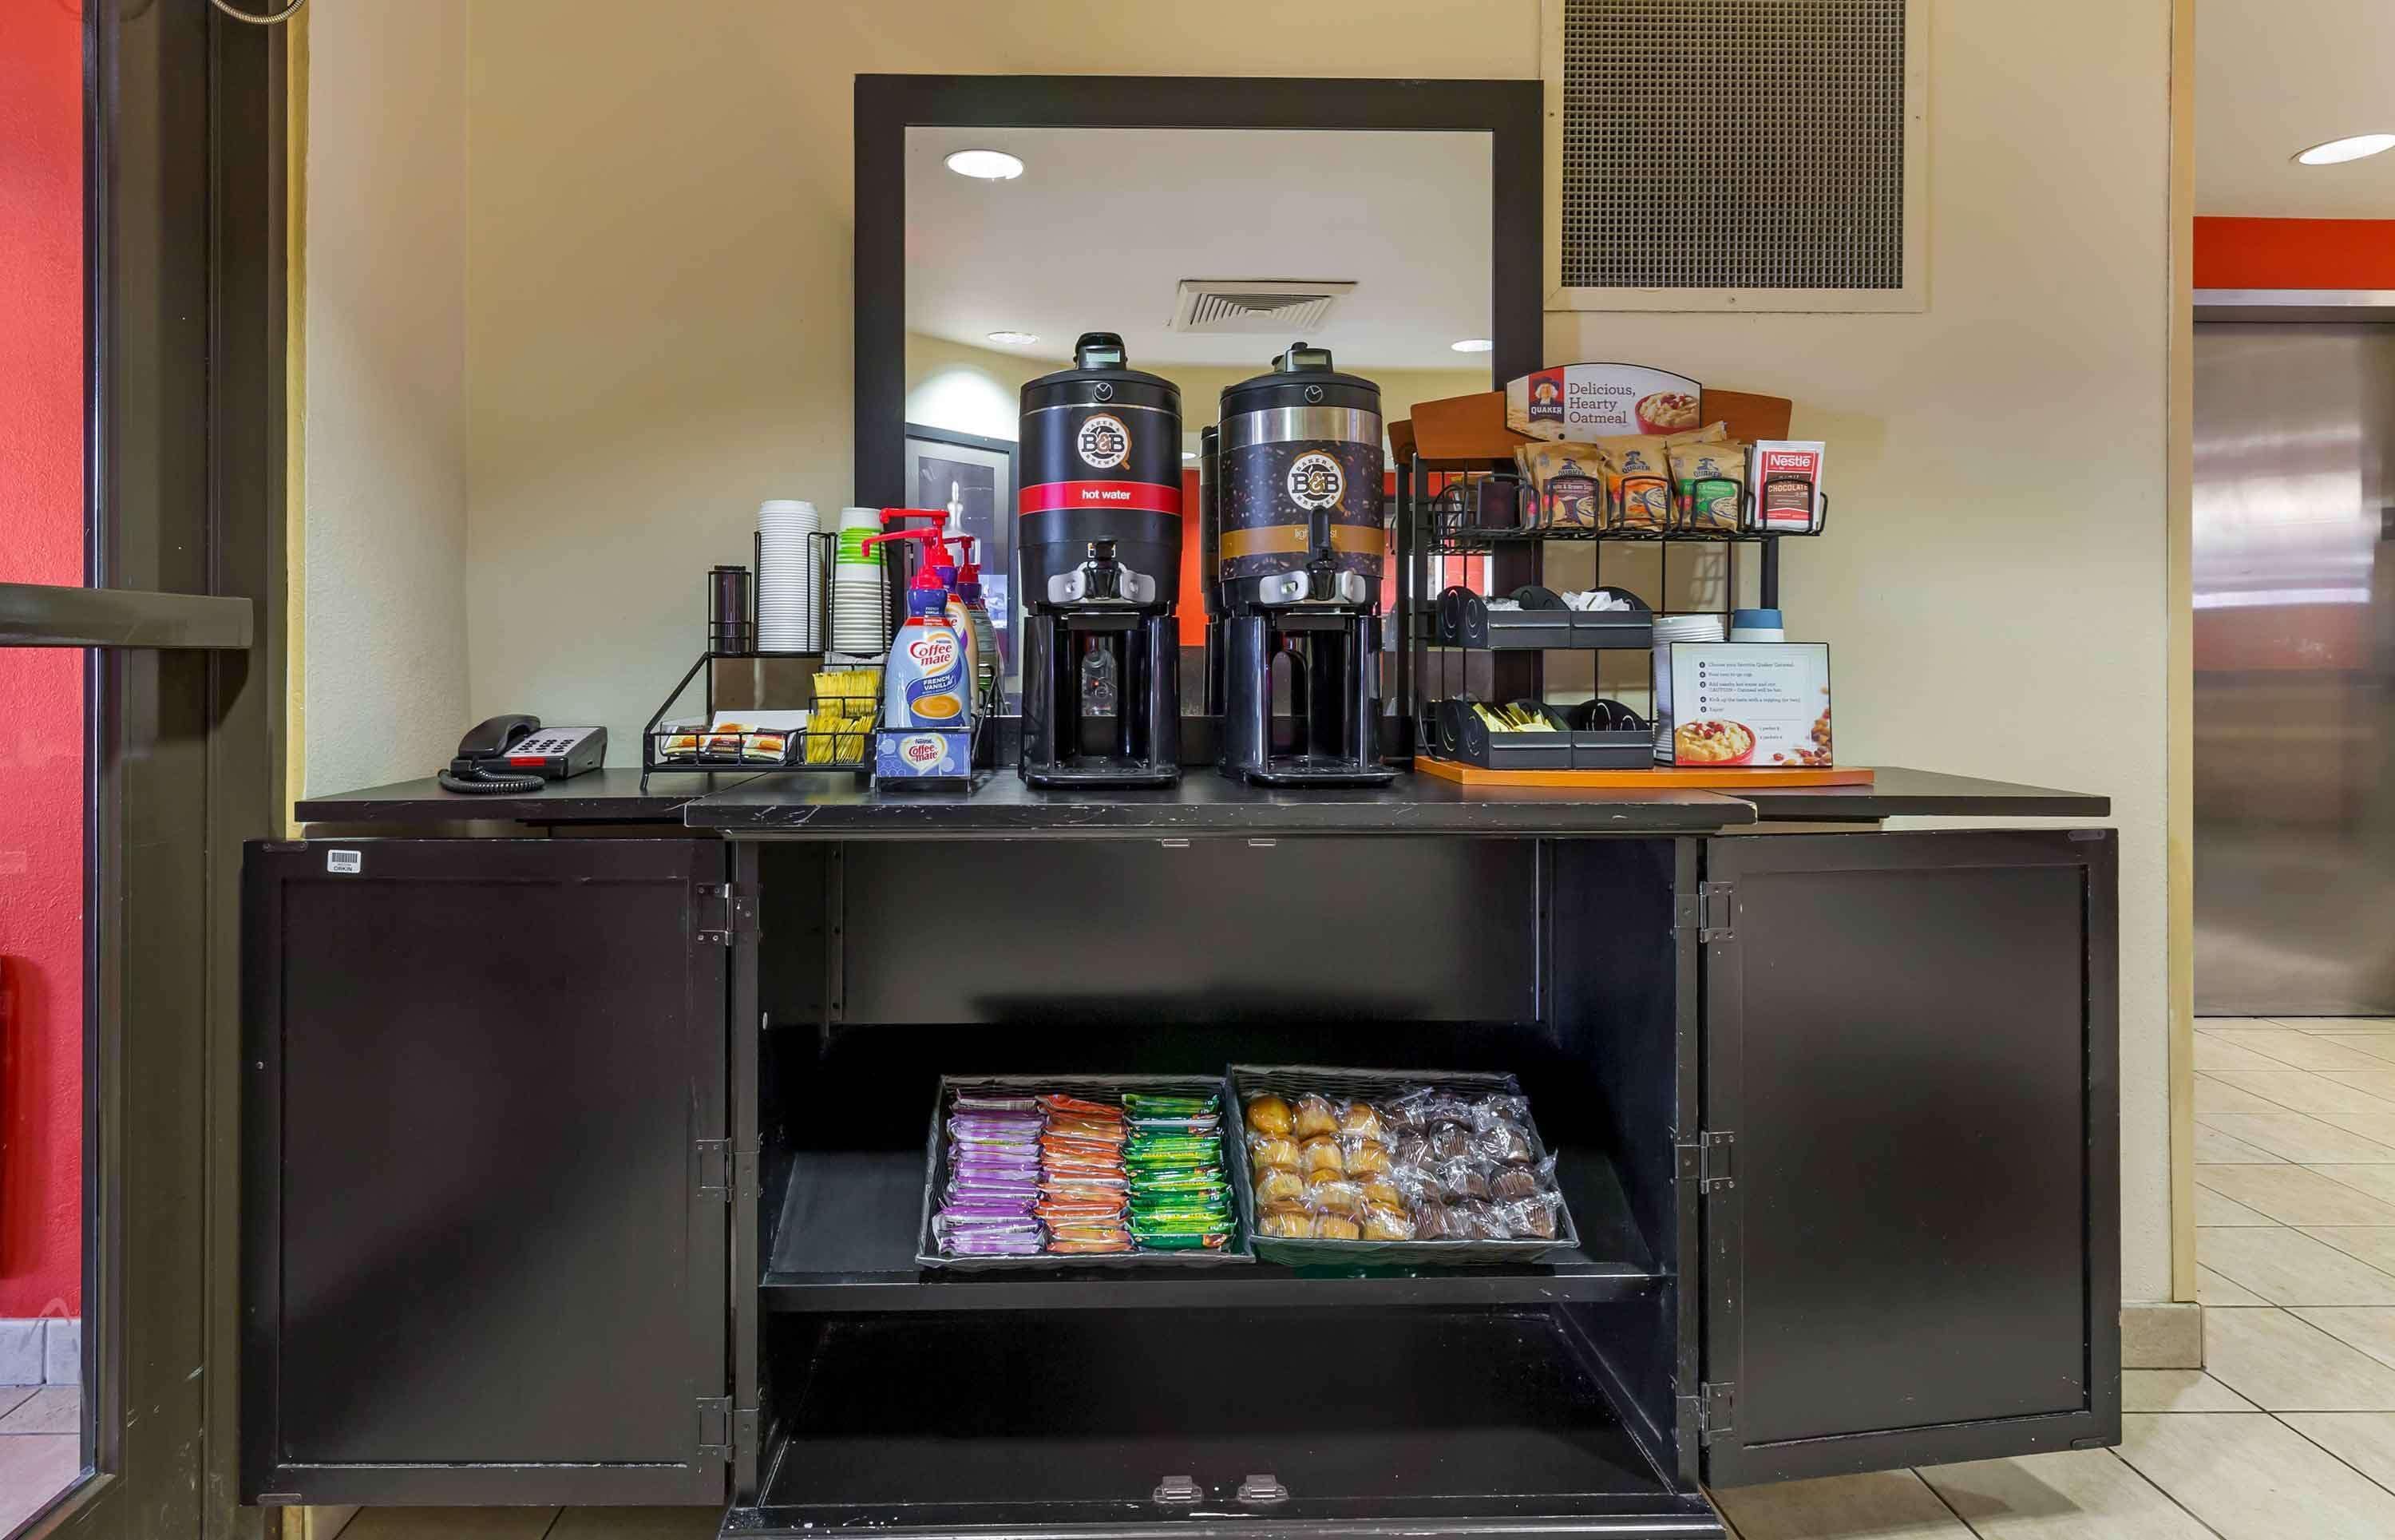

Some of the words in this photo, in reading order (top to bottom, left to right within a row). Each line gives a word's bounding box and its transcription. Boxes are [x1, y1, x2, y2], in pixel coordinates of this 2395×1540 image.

[1569, 382, 1637, 396] Delicious,
[1530, 406, 1562, 415] QUAKER
[1569, 397, 1617, 412] Hearty
[1569, 411, 1627, 424] Oatmeal
[1081, 433, 1126, 453] B&B
[1291, 473, 1340, 493] B&B
[1082, 489, 1100, 499] hot
[1102, 490, 1131, 500] water
[910, 641, 952, 659] Coffee
[920, 653, 951, 667] mate
[923, 675, 951, 686] FRENCH
[924, 679, 954, 691] VANILLA
[909, 744, 936, 758] Coffee
[915, 751, 938, 762] mate
